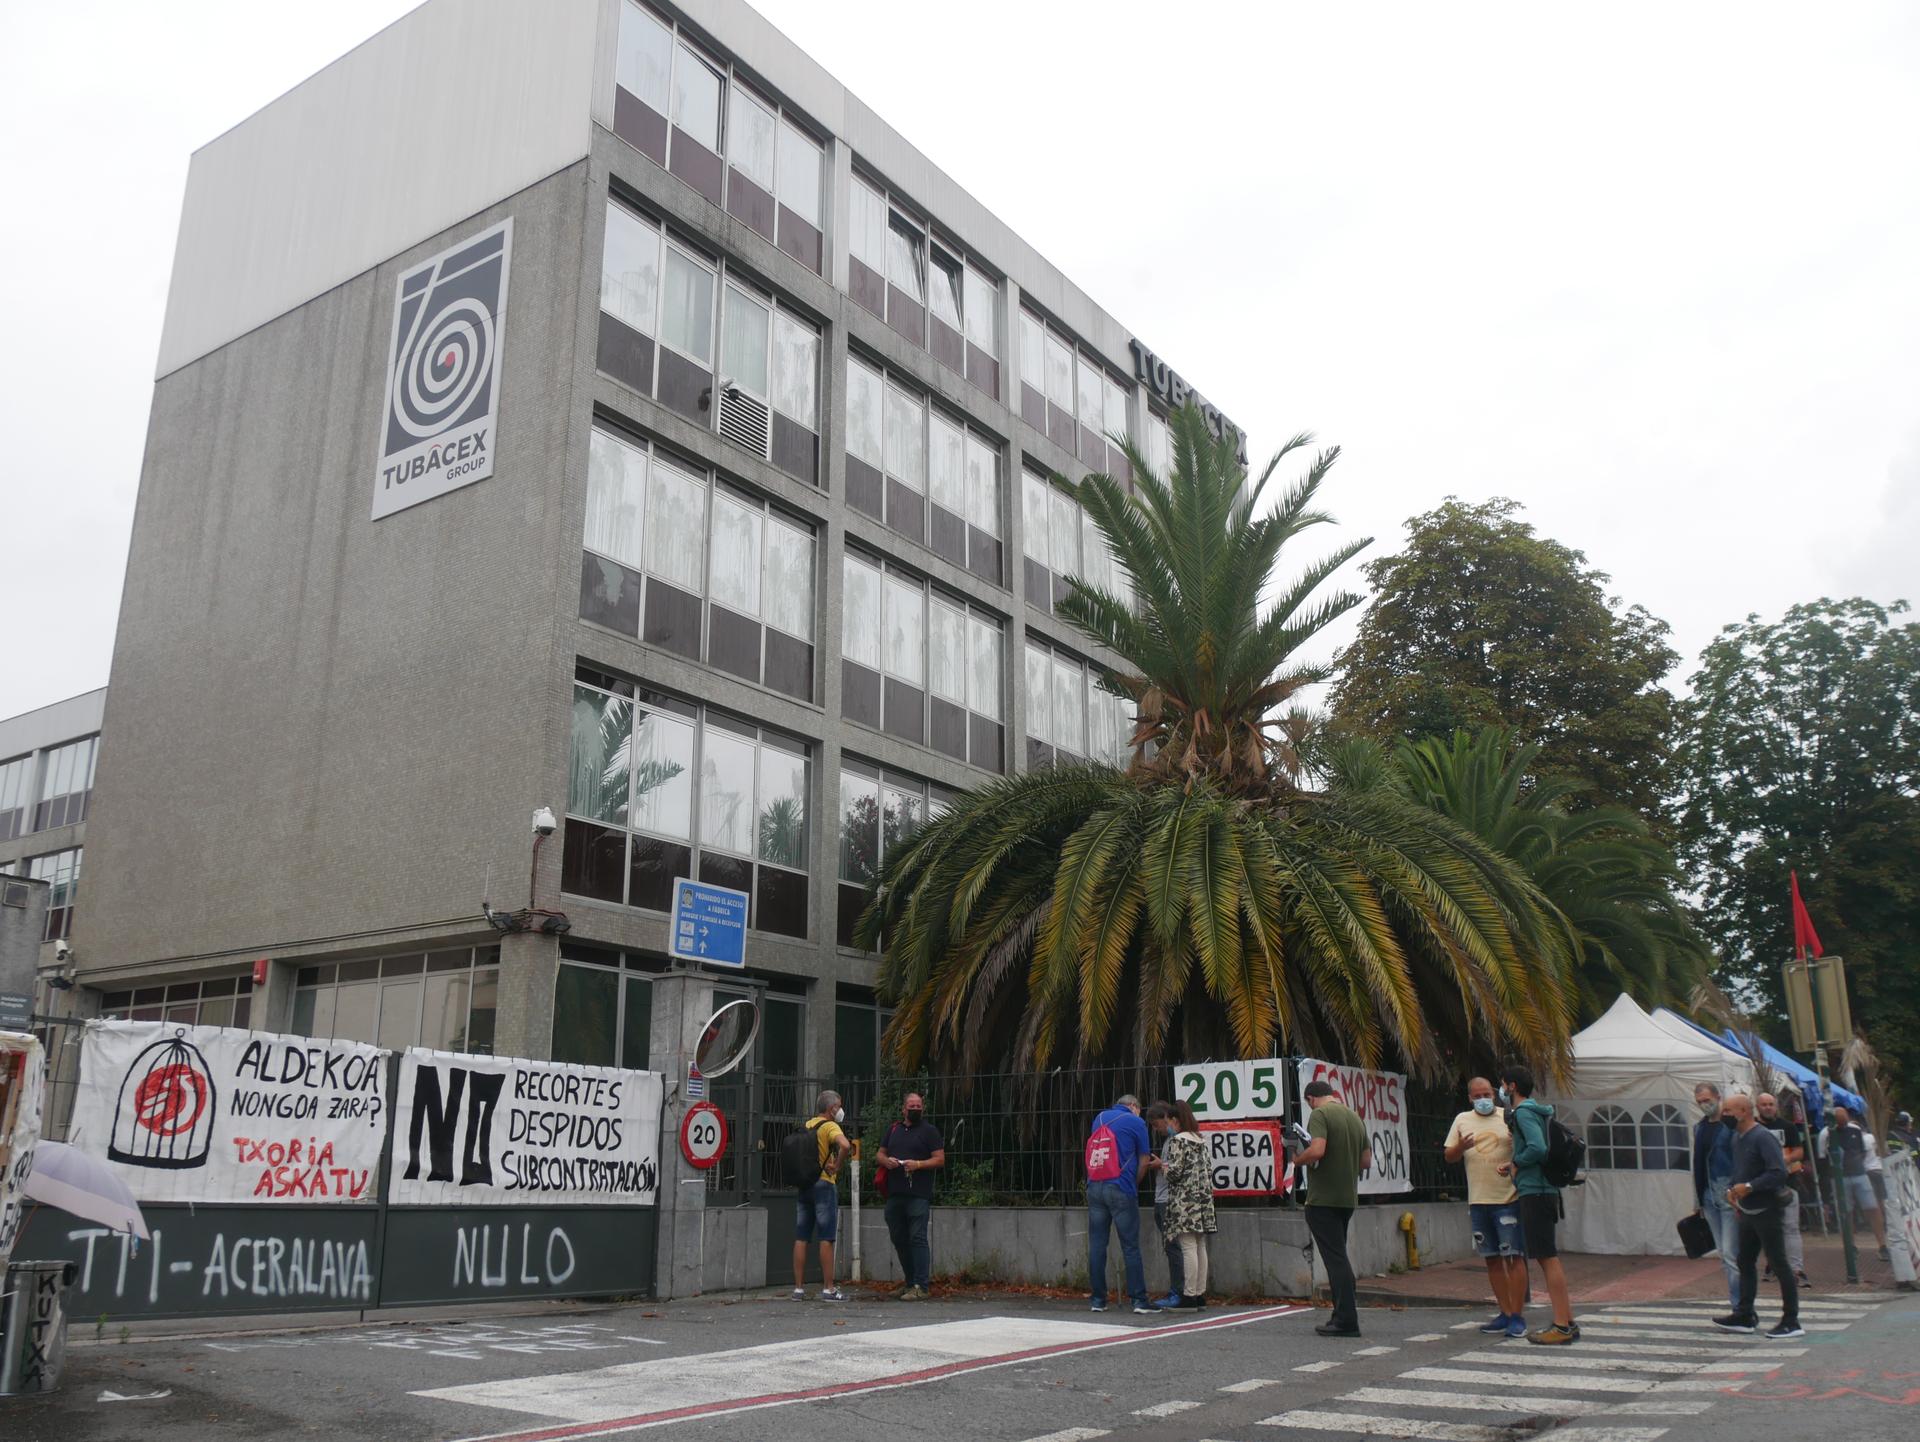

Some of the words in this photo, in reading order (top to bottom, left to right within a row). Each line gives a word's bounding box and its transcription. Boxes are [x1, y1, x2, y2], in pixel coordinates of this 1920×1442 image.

[446, 457, 486, 480] GROUP
[234, 1040, 380, 1094] ALDEKOA
[231, 1089, 317, 1120] NONGOA
[327, 1097, 383, 1128] ZARA?
[514, 1069, 623, 1110] RECORTES
[402, 1064, 506, 1187] NO
[509, 1108, 623, 1151] DESPIDOS
[693, 1124, 716, 1145] 20
[1211, 1133, 1273, 1160] REBA
[253, 1167, 369, 1198] ASKATU
[500, 1150, 657, 1193] SUBCONTRATACIÓN
[1212, 1165, 1273, 1190] GUN
[453, 1222, 576, 1288] NULO
[20, 1273, 57, 1390] KUTXA
